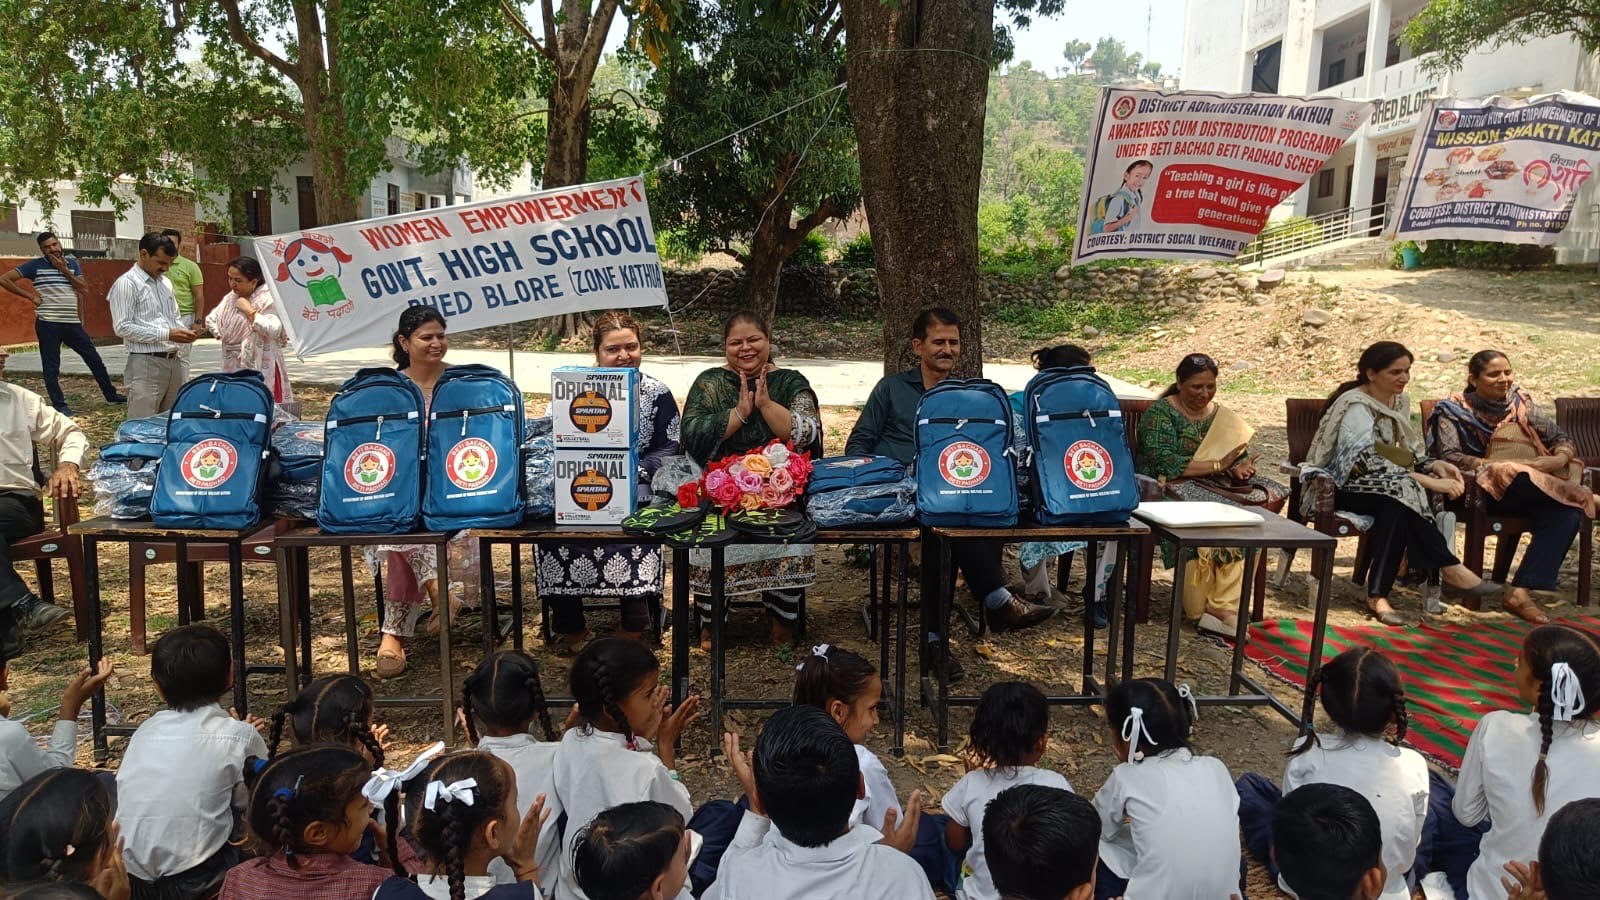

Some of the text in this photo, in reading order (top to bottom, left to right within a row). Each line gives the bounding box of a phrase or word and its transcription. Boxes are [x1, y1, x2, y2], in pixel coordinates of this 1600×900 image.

[1138, 98, 1334, 126] DISTRICT ADMINISTRATION KATHUA
[1584, 112, 1595, 126] OF
[1107, 120, 1170, 140] AWARENESS
[1172, 120, 1197, 137] CUM
[1199, 120, 1277, 143] DISTRIBUTION
[1435, 128, 1499, 147] MISSION
[1504, 121, 1564, 140] SHAKTI
[1116, 142, 1147, 159] UNDER
[1150, 141, 1171, 158] BETI
[1174, 140, 1215, 158] BACHAO
[1216, 143, 1239, 160] BETI
[1241, 148, 1283, 168] PADHAO
[1216, 175, 1223, 184] a
[1225, 176, 1244, 191] girl
[1246, 179, 1256, 193] is
[1257, 182, 1278, 198] like
[1166, 190, 1173, 198] a
[1175, 188, 1195, 200] tree
[1197, 189, 1218, 203] that
[1220, 194, 1238, 208] will
[1239, 199, 1262, 214] give
[1410, 205, 1453, 220] COURTESY:
[1454, 202, 1495, 217] DISTRICT
[359, 180, 642, 252] WOMEN EMPOWERMENT
[1086, 236, 1127, 249] COURTESY:
[1129, 233, 1165, 246] DISTRICT
[1167, 233, 1196, 245] SOCIAL
[1198, 235, 1238, 250] WELFARE
[361, 216, 656, 300] GOVT. HIGH SCHOOL
[482, 275, 563, 306] BLORE
[568, 266, 618, 297] (ZONE
[575, 407, 608, 415] SPARTAN
[575, 485, 609, 493] SPARTAN
